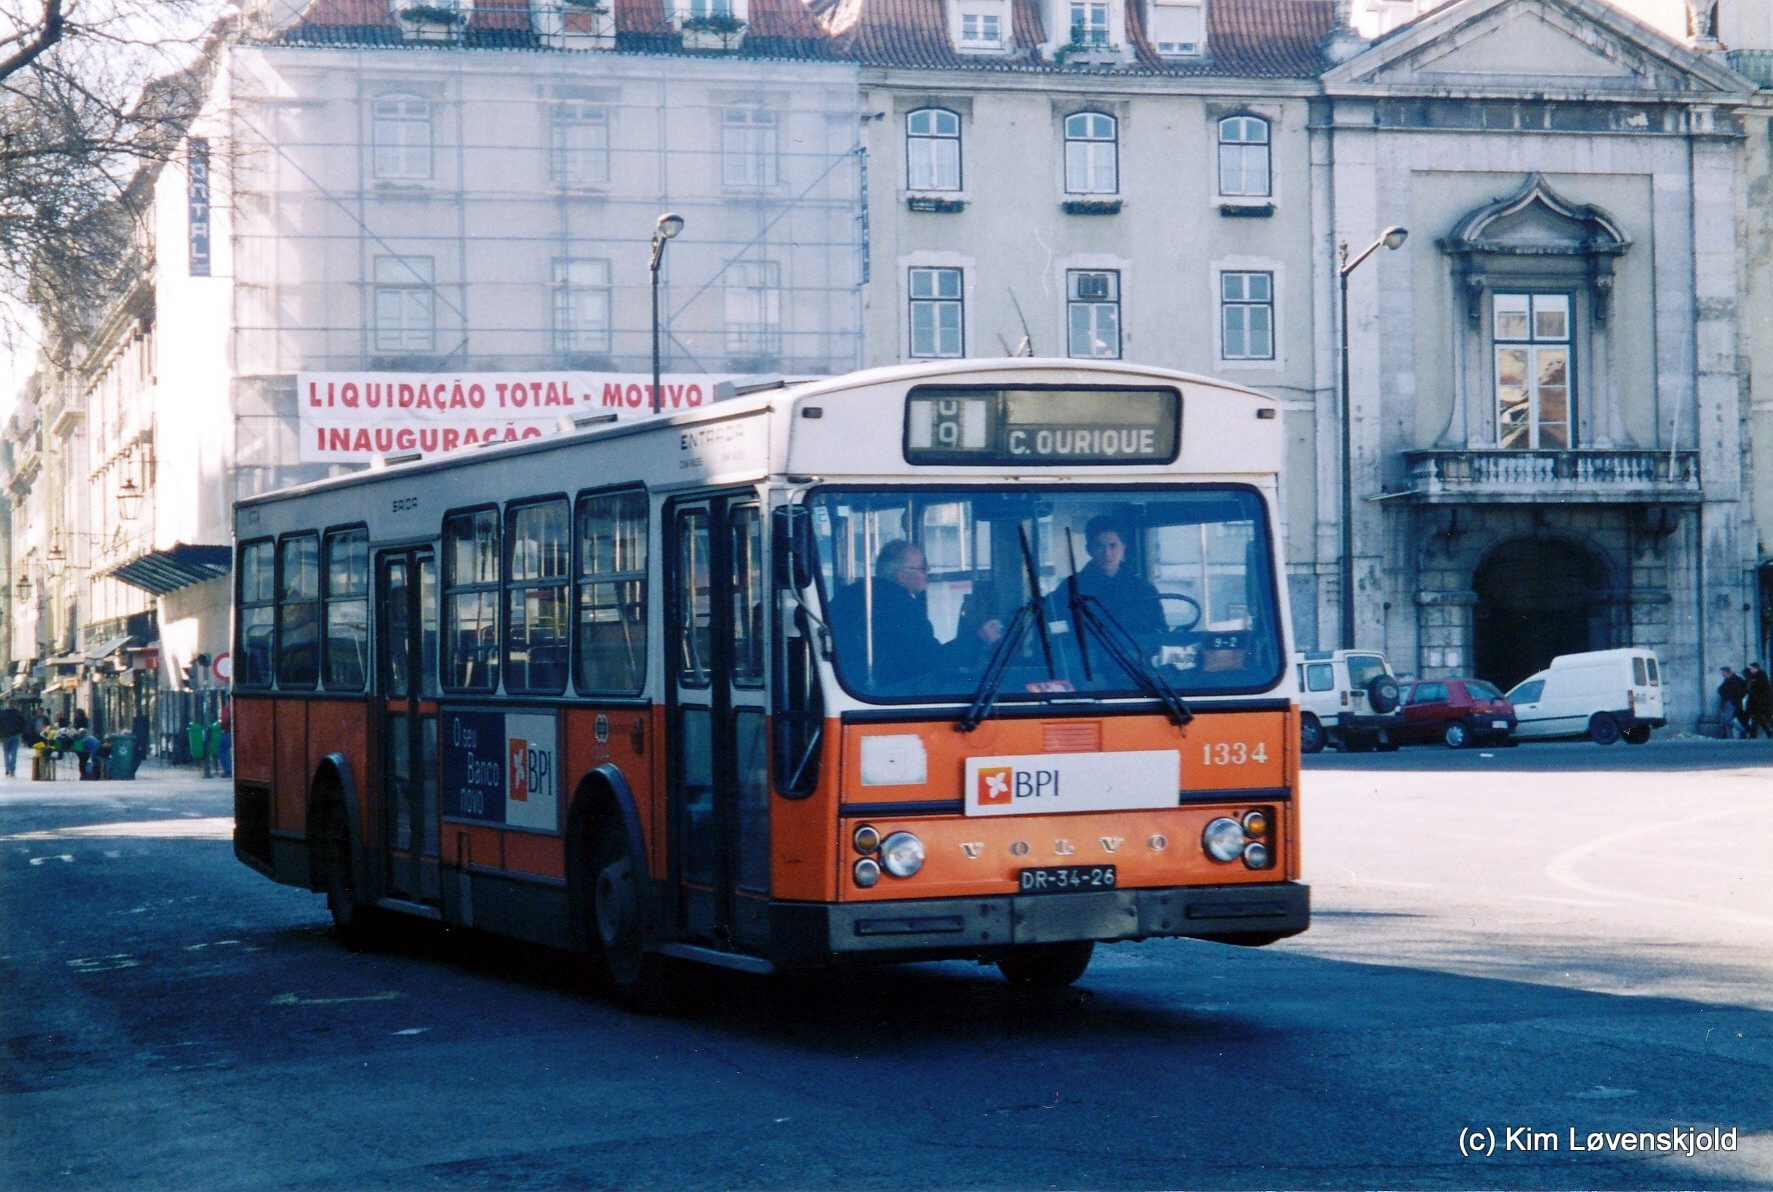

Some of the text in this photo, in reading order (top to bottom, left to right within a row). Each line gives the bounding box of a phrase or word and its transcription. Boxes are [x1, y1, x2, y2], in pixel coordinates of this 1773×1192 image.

[309, 379, 485, 413] LIQUIDAÇÃO
[495, 382, 574, 407] TOTAL
[601, 383, 703, 408] MOTIVO
[681, 423, 744, 451] ENTRADA
[1008, 430, 1031, 454] C.
[1036, 429, 1155, 455] OURIQUE
[453, 717, 477, 749] O seu
[1202, 742, 1269, 767] 1334
[467, 751, 499, 787] Banco
[528, 749, 552, 796] BPI
[1015, 769, 1060, 798] BPI
[460, 787, 484, 815] novo
[959, 833, 1169, 860] VOLVO
[1021, 867, 1115, 890] DR-34-26
